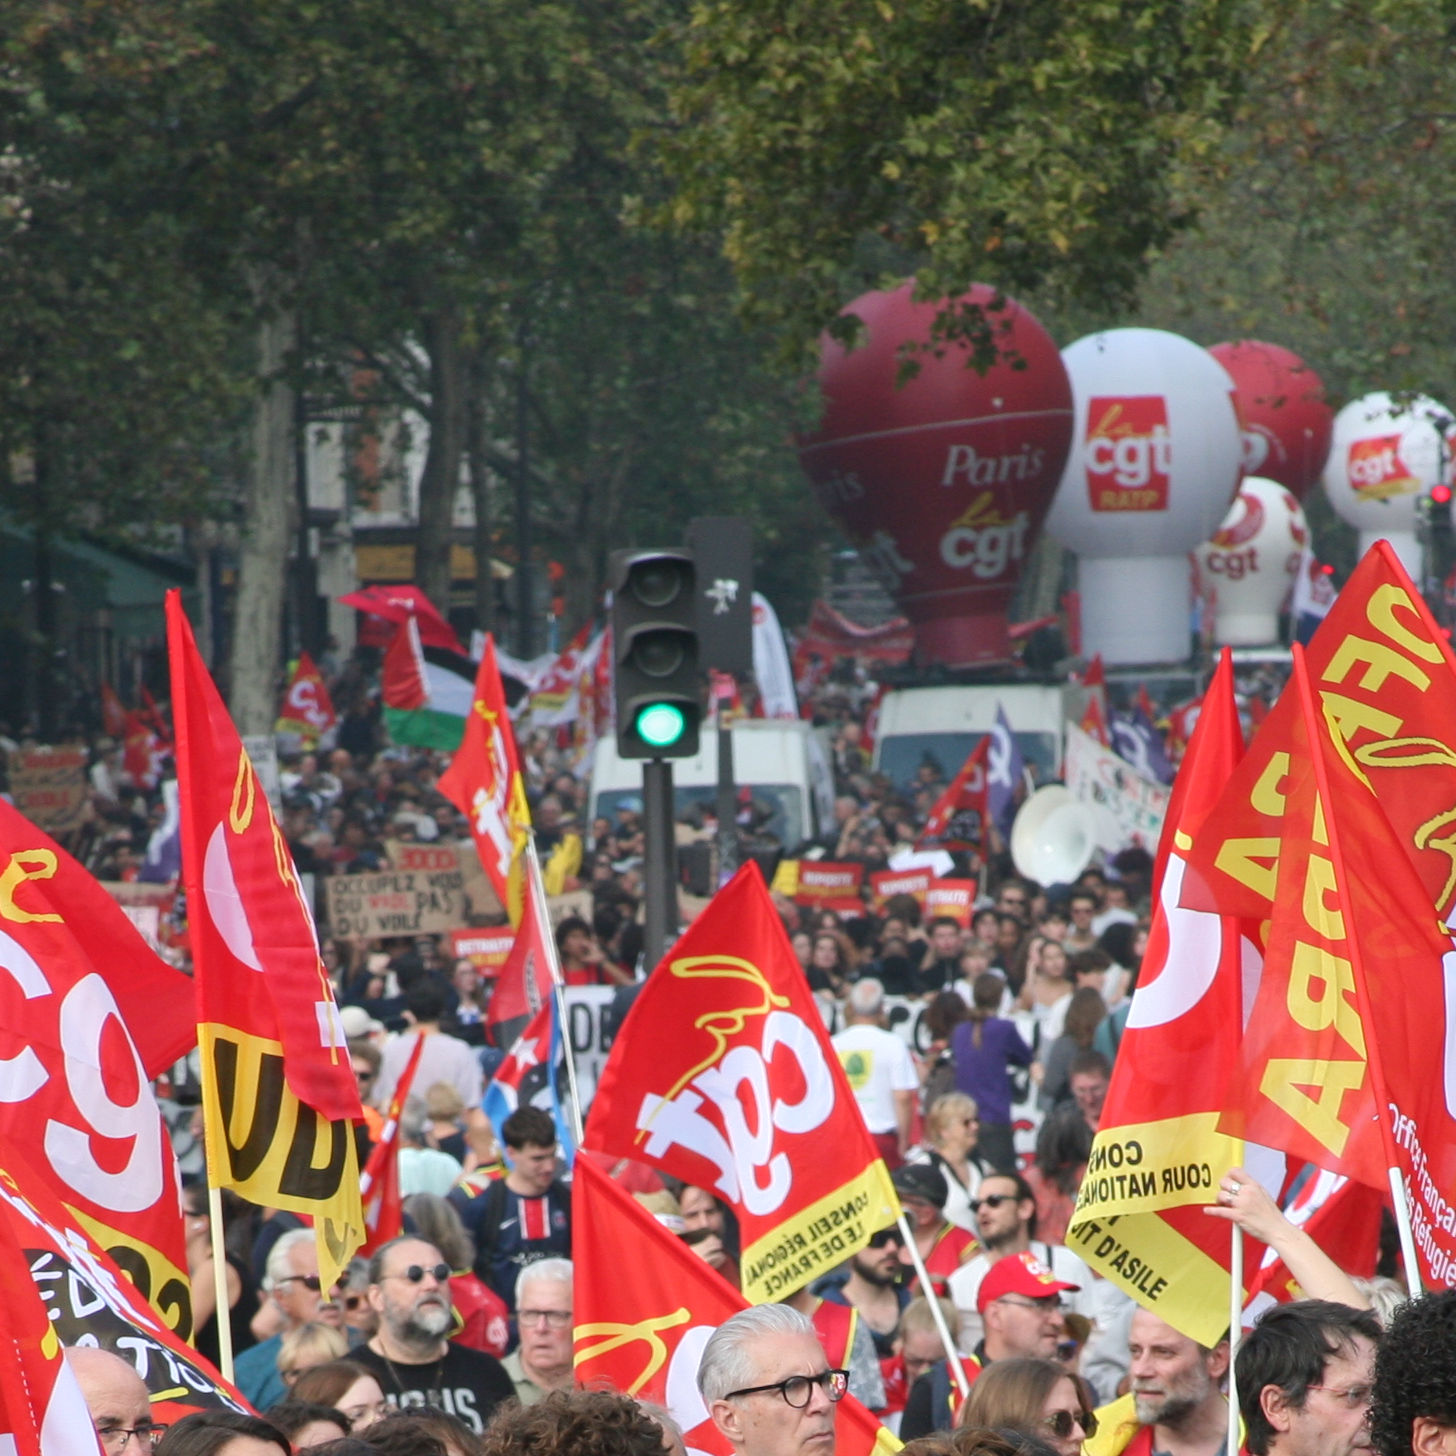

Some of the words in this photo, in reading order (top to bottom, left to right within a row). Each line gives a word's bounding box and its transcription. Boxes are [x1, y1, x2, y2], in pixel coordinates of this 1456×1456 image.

[943, 444, 1045, 487] Paris
[1085, 424, 1172, 488] cgt
[1349, 446, 1397, 485] cgt
[1099, 490, 1159, 509] RATP
[940, 512, 1030, 579] cgt
[1206, 549, 1259, 581] cgt
[334, 874, 415, 894] OCCUPEZ
[416, 891, 454, 915] PAS
[337, 914, 369, 934] DU
[1094, 1236, 1169, 1303] D'ASILE
